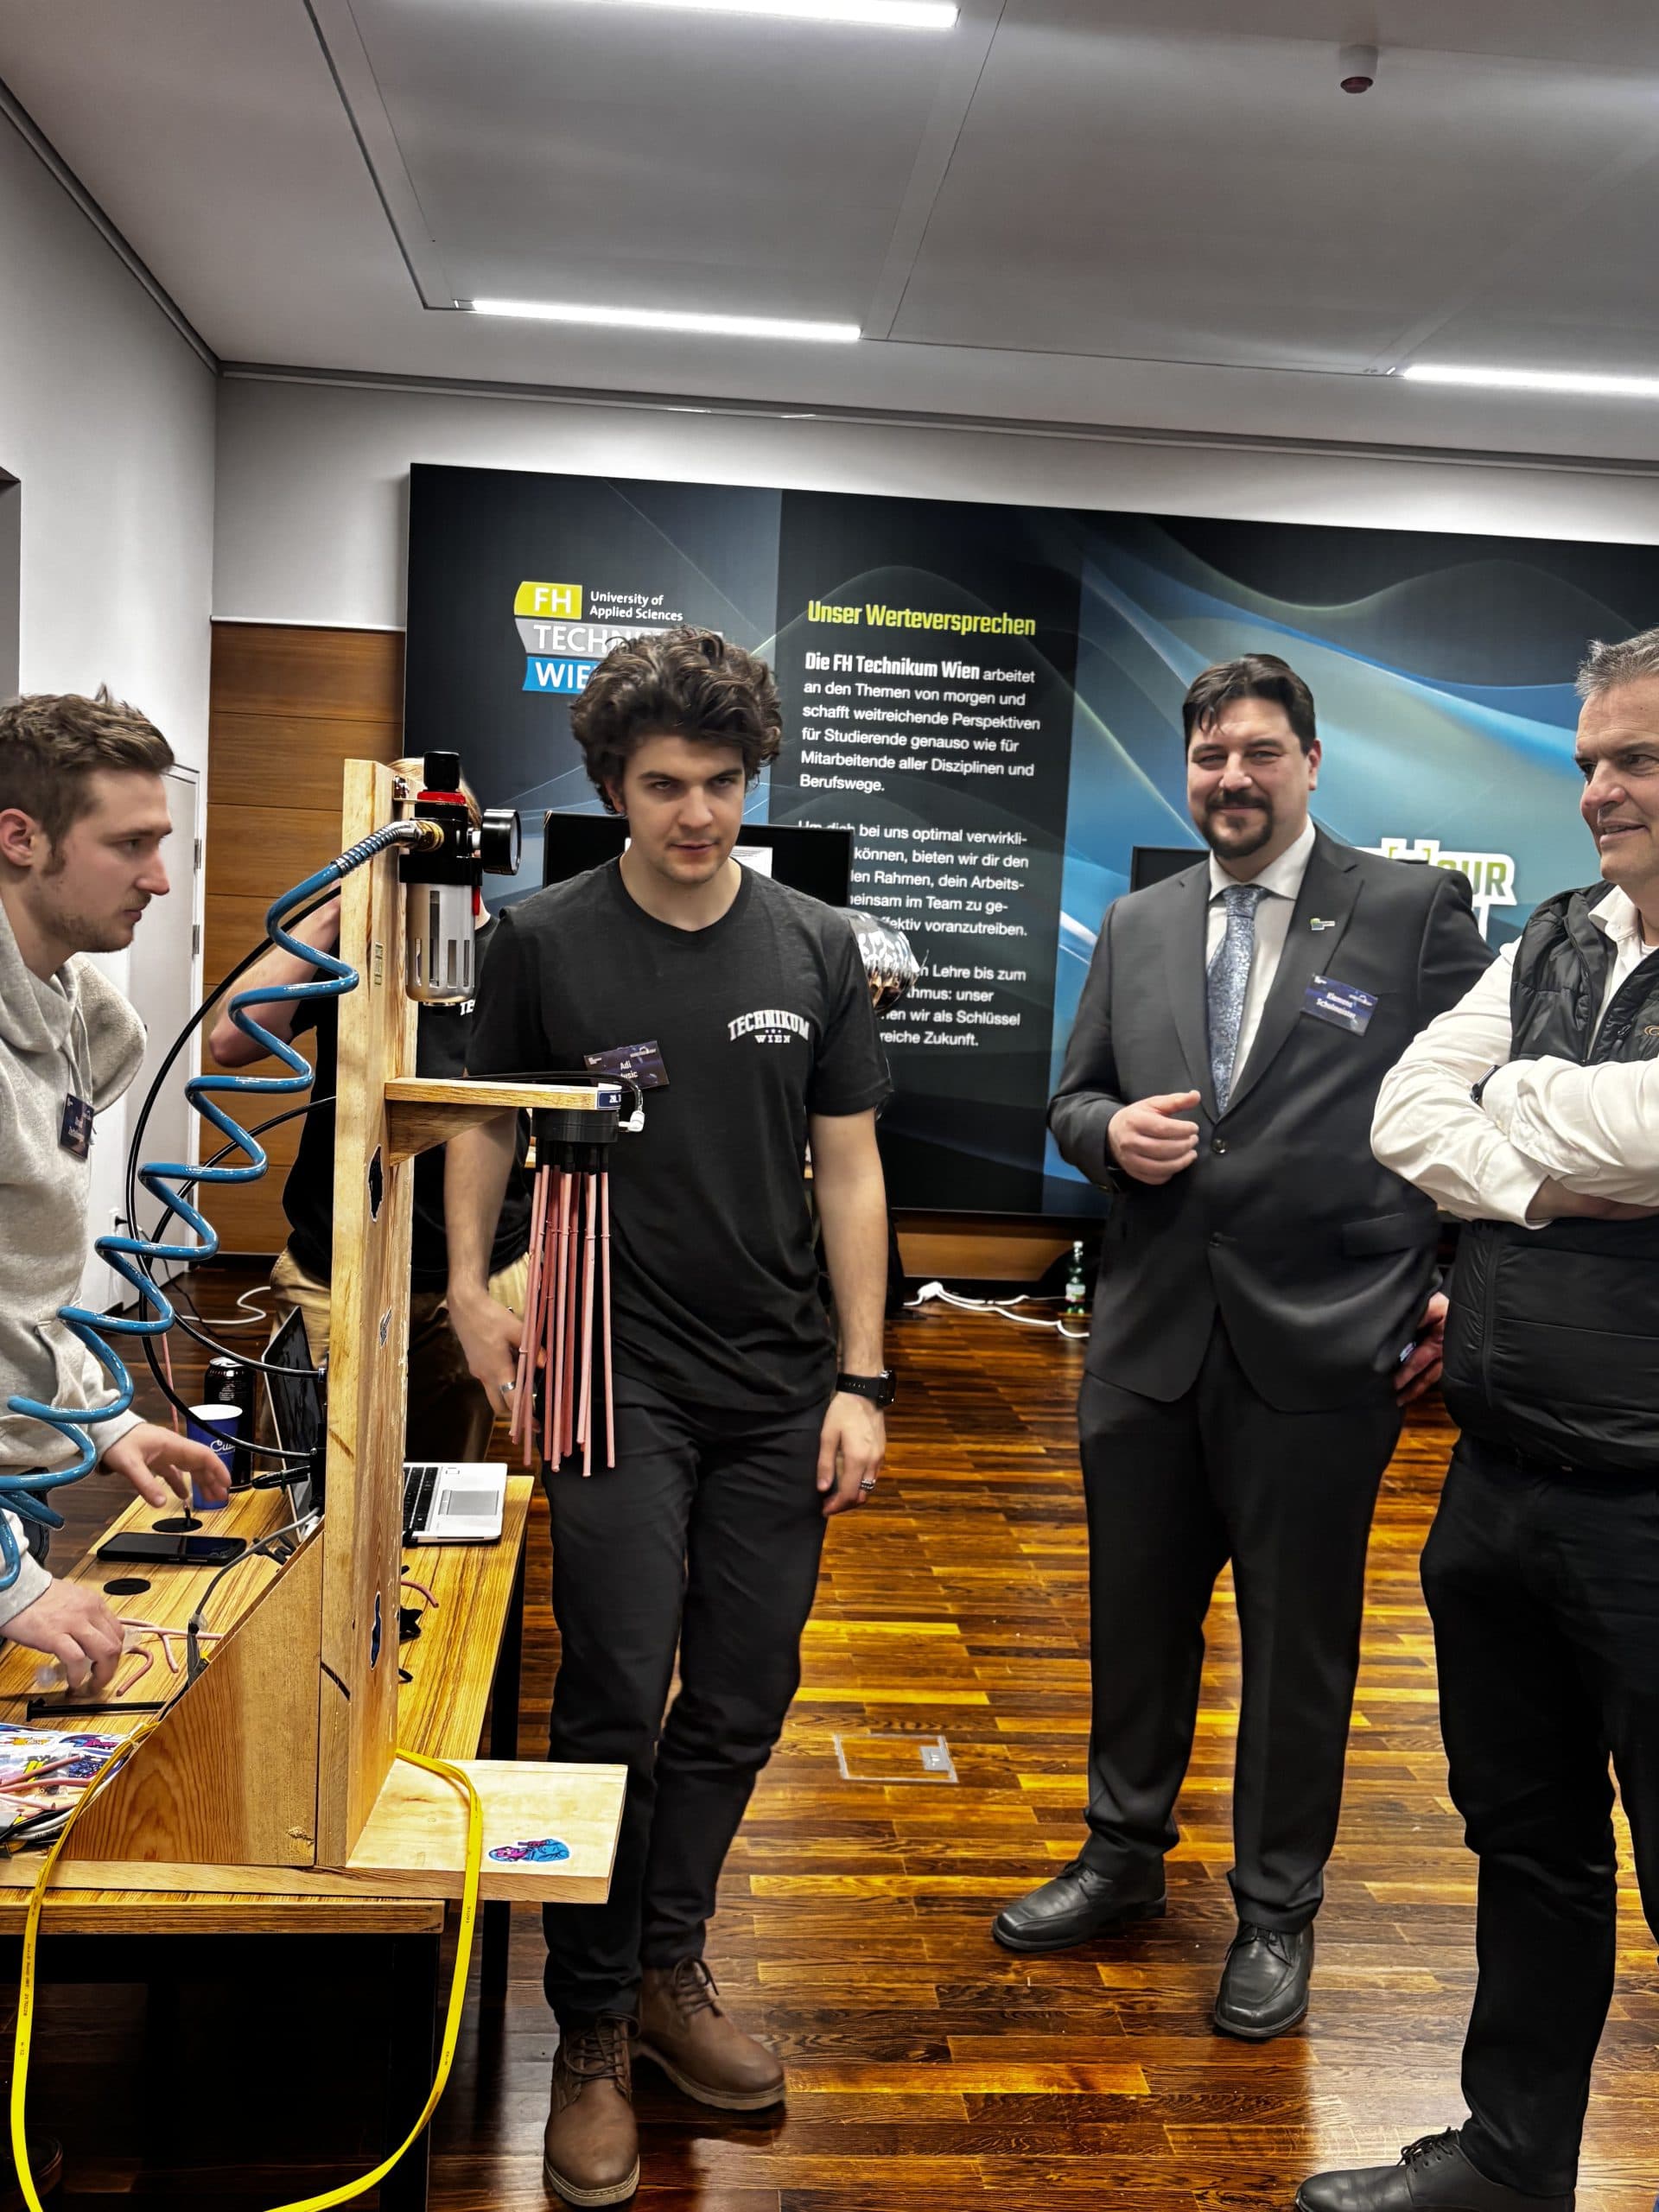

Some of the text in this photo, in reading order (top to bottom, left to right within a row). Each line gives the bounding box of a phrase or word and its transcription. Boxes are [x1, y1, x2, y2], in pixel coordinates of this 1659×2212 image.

[534, 588, 571, 613] FH
[590, 591, 664, 607] University of
[589, 606, 683, 623] Applied Sciences
[808, 600, 1036, 636] Unser Werteversprechen
[535, 662, 596, 690] WIE
[805, 652, 1035, 683] Die FH Technikum Wien arbeitet
[804, 682, 1026, 706] an den Themen von morgen und
[803, 705, 1040, 730] schafft weitreichende Perspektiven
[802, 728, 1020, 753] für Studierende genauso wie für
[801, 751, 1034, 777] Mitarbeitende aller Disziplinen und
[800, 774, 885, 793] Berufswege.
[860, 823, 880, 838] bei
[884, 828, 908, 839] uns
[912, 829, 963, 843] optimal
[966, 831, 1027, 845] verwirkli-
[854, 848, 1028, 869] können, bieten wir dir den
[874, 870, 935, 888] Rahmen,
[938, 874, 967, 887] dein
[971, 876, 1024, 891] Arbeits-
[850, 893, 1007, 914] einsam im Team zu ge-
[925, 920, 1027, 936] voranzutreiben.
[932, 964, 970, 979] Lehre
[974, 967, 994, 980] bis
[997, 969, 1027, 982] zum
[957, 989, 994, 1002] unser
[728, 1009, 810, 1041] TECHNIKUM
[910, 1008, 930, 1021] wir
[933, 1009, 952, 1023] als
[957, 1011, 1020, 1027] Schlüssel
[880, 1030, 979, 1046] reiche Zukunft.
